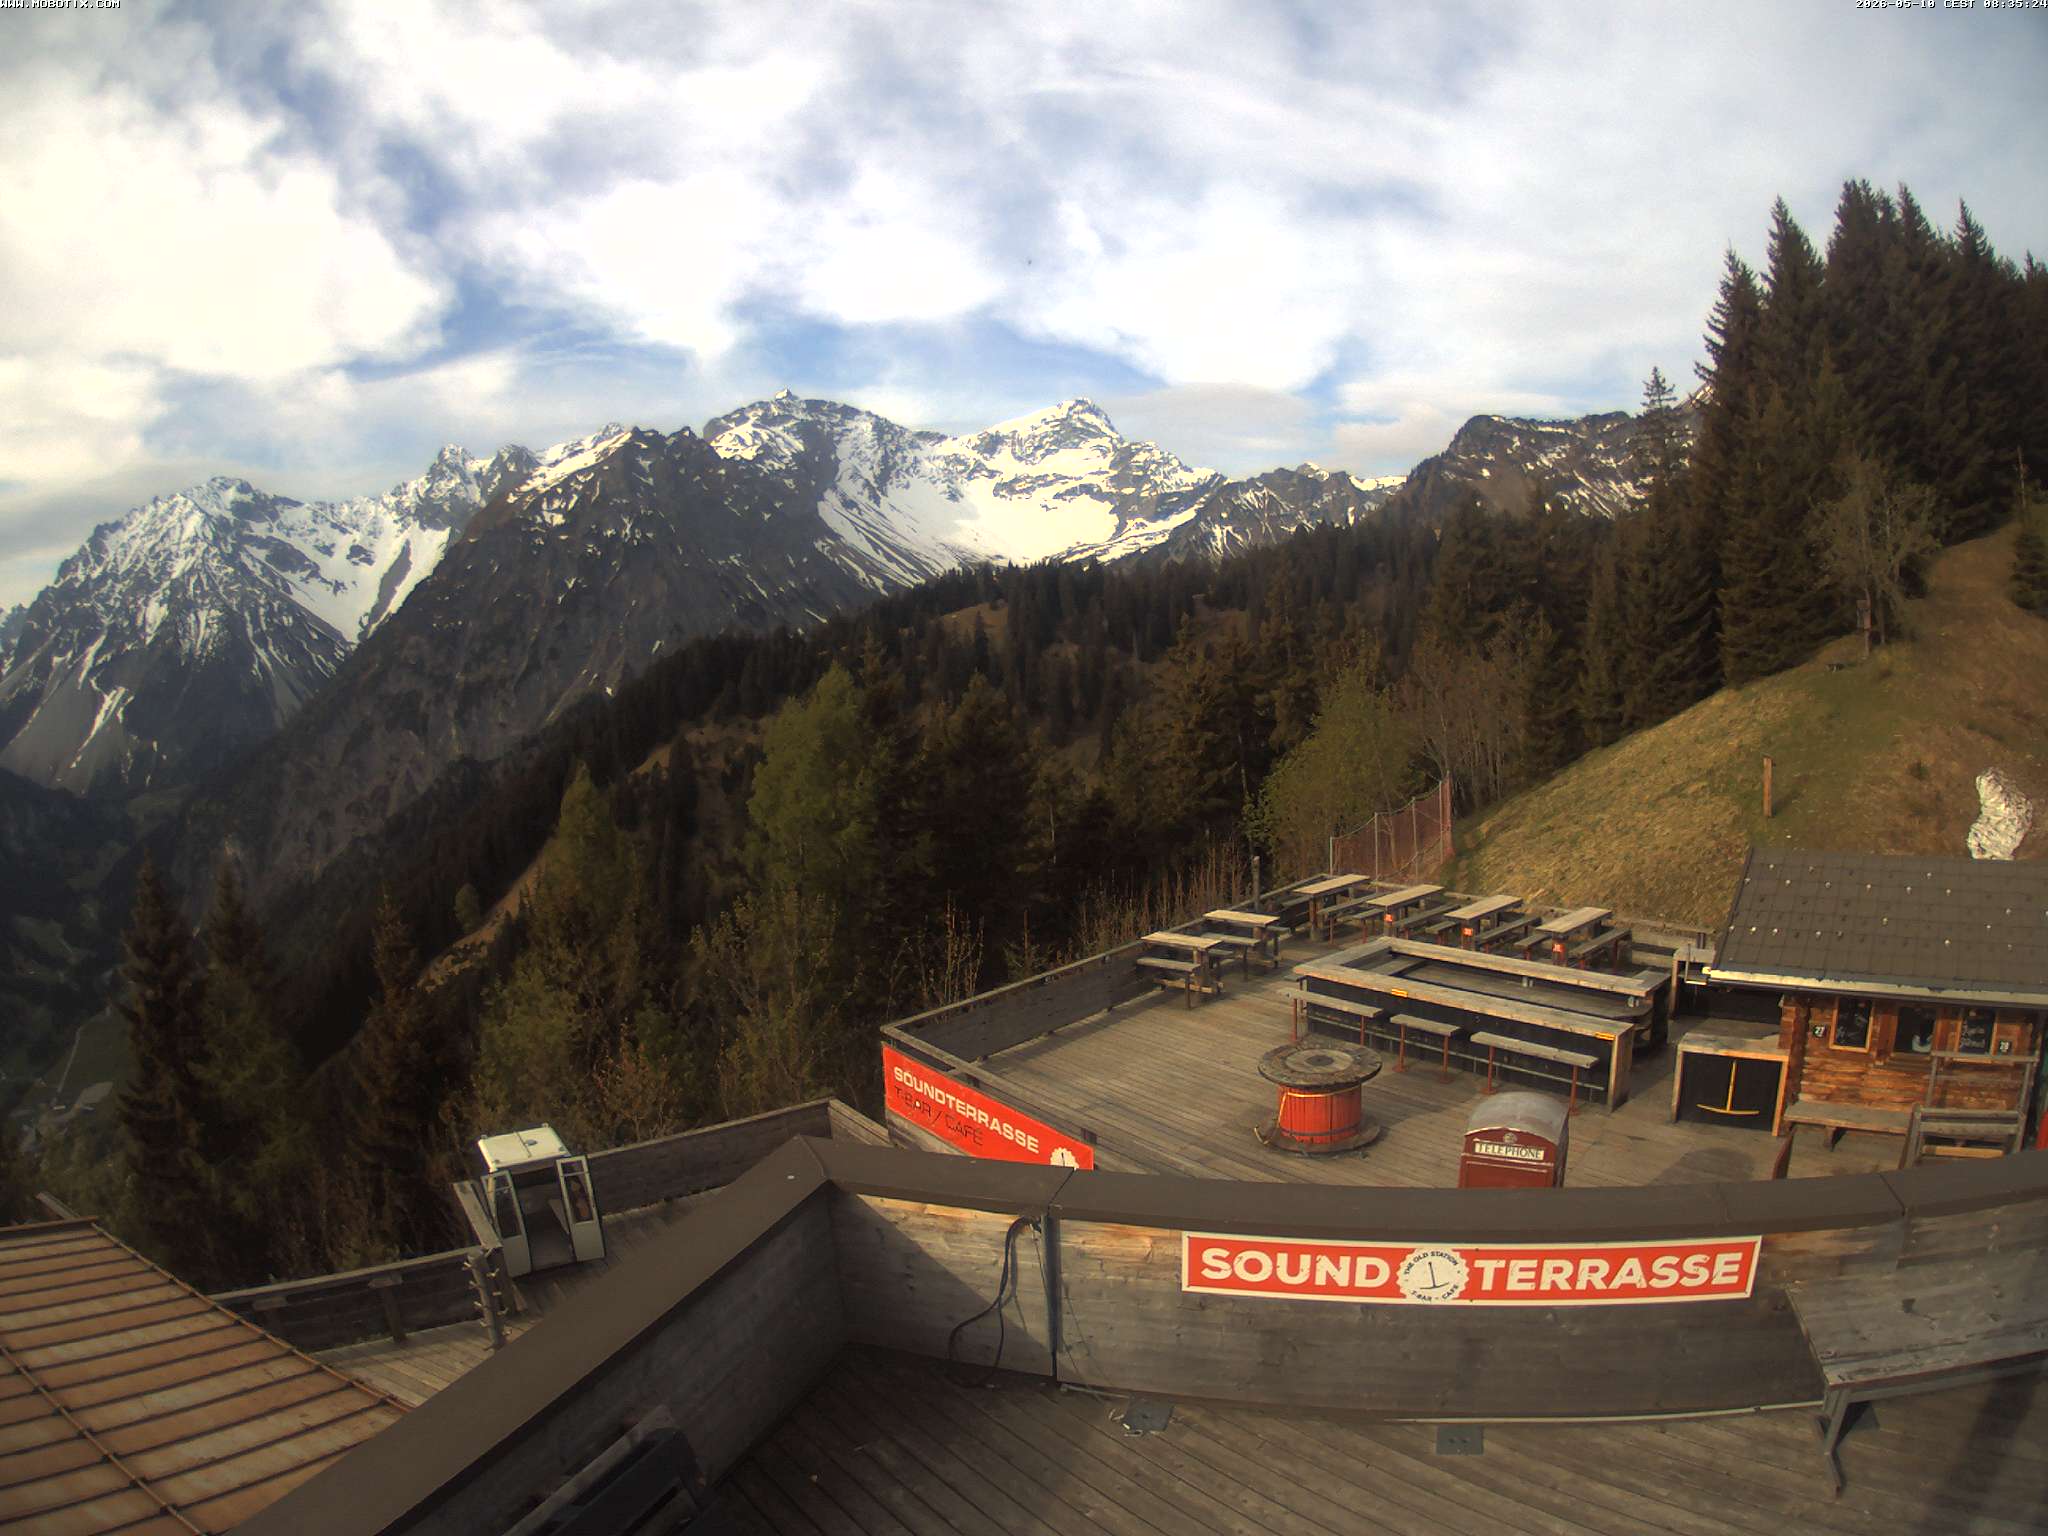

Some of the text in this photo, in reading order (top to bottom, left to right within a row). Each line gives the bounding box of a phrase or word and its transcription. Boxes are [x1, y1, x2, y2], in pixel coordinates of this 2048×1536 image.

[893, 1066, 1040, 1155] SOUNDTERRASSE
[1477, 1143, 1542, 1159] TELEPHONE
[1200, 1247, 1391, 1288] SOUND
[1413, 1252, 1429, 1262] OLD
[1473, 1252, 1744, 1291] TERRASSE
